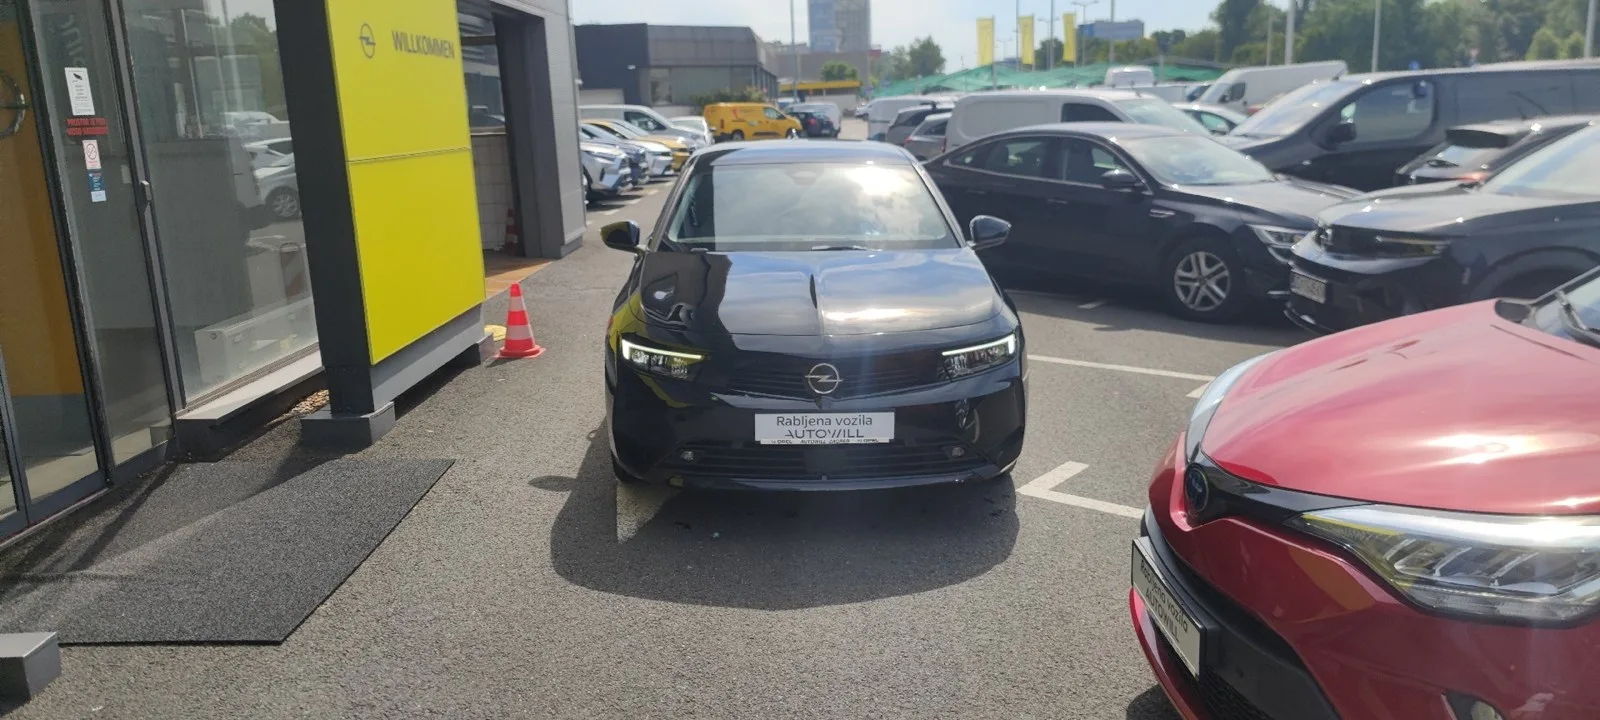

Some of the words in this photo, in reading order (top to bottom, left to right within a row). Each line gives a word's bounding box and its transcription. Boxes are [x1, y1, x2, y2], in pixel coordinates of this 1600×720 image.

[391, 31, 455, 58] WILLKOMMEN
[776, 416, 831, 428] Rabljena
[835, 415, 873, 426] vozila
[785, 429, 864, 439] AUTOWILL
[1145, 588, 1179, 642] AUTOWILL
